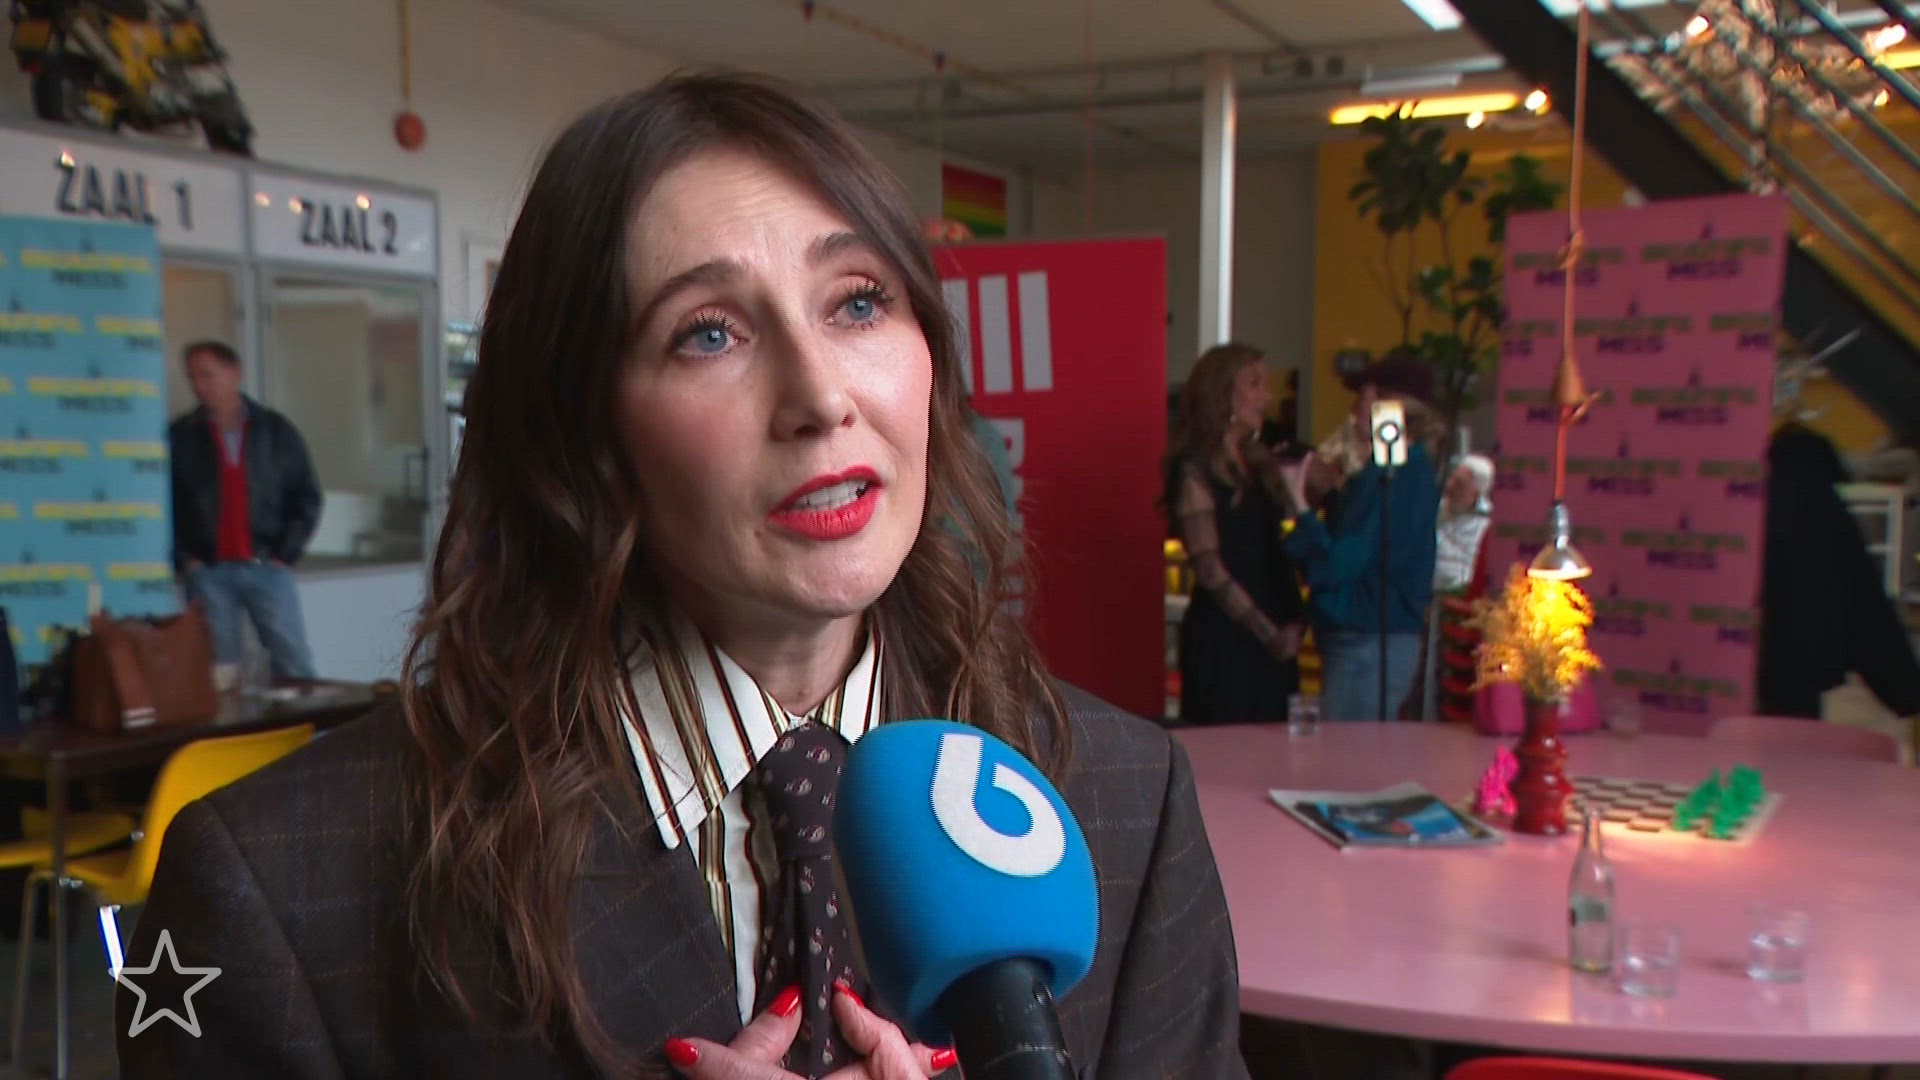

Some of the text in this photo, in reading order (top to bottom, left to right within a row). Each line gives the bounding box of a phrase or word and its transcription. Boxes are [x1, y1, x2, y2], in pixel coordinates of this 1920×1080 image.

[54, 157, 194, 231] ZAAL 1
[299, 197, 399, 256] ZAAL 2
[931, 733, 1067, 878] 6
